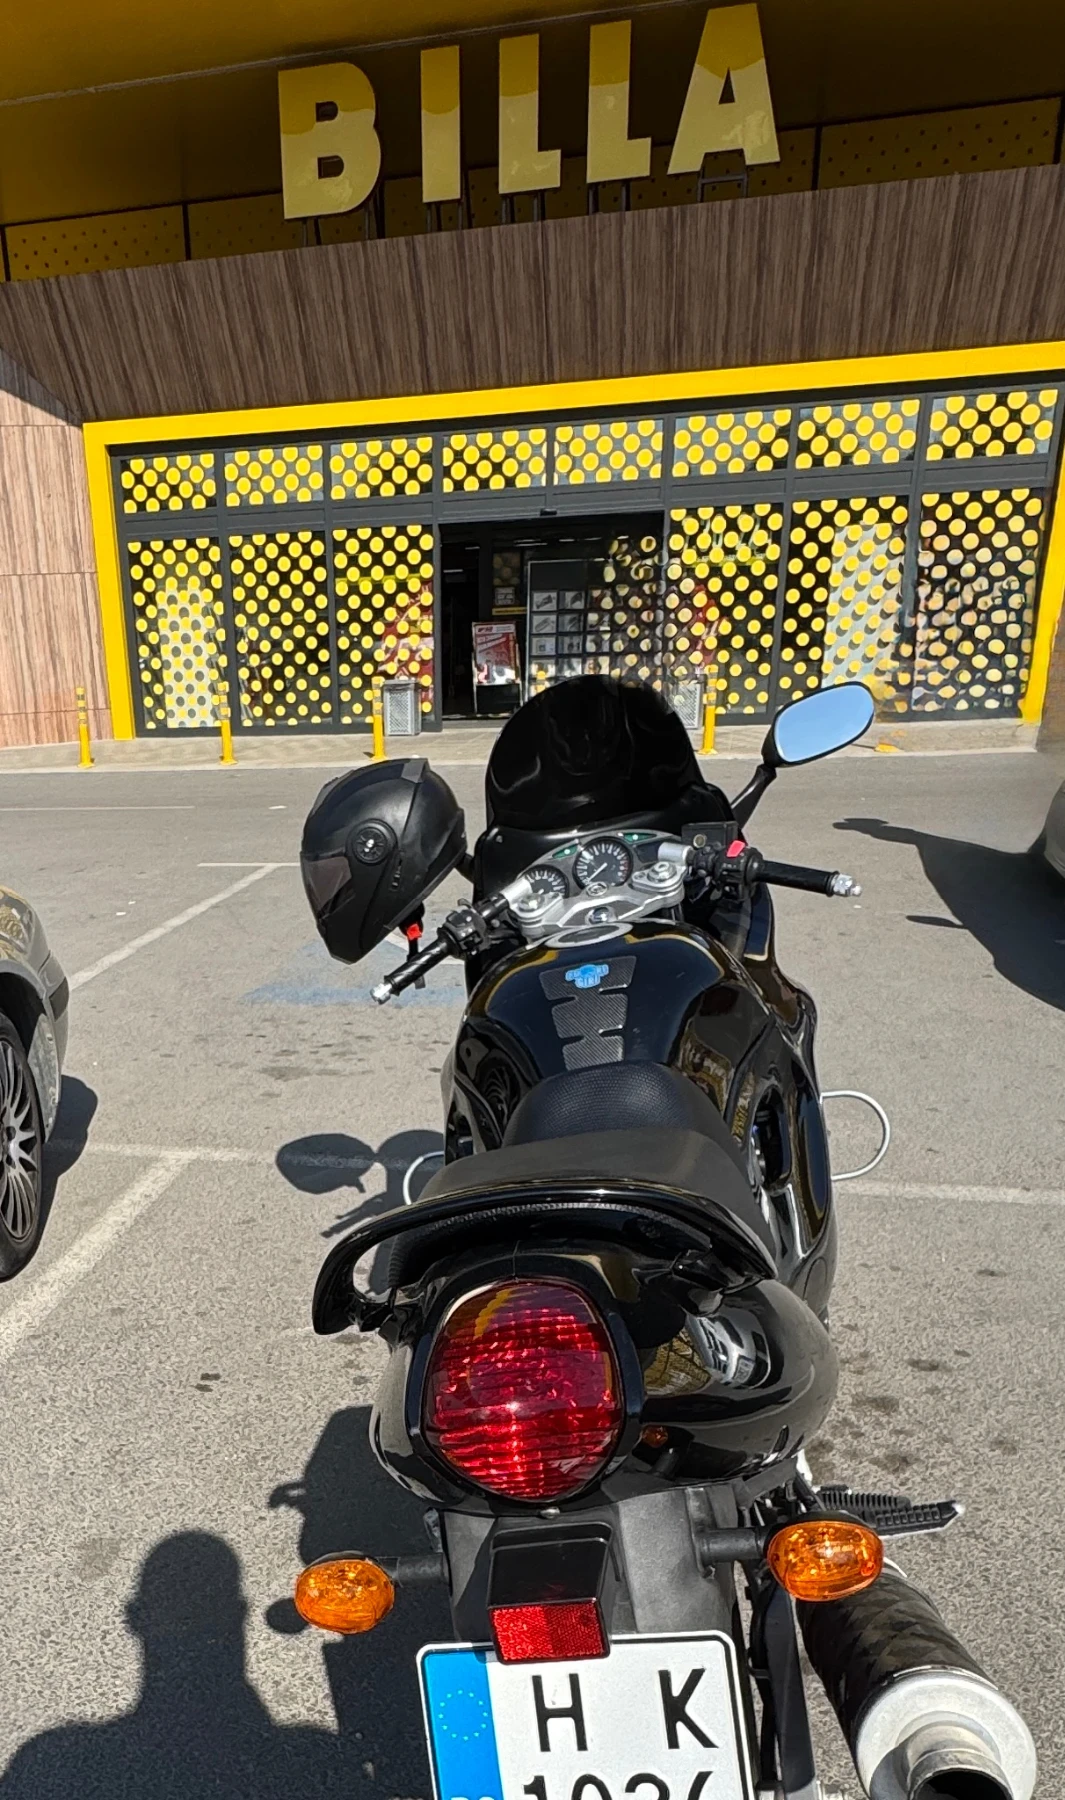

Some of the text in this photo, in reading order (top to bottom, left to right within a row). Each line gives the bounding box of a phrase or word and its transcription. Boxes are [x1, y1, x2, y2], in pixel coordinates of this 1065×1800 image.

[278, 3, 780, 220] BILLA
[531, 1668, 719, 1752] H K
